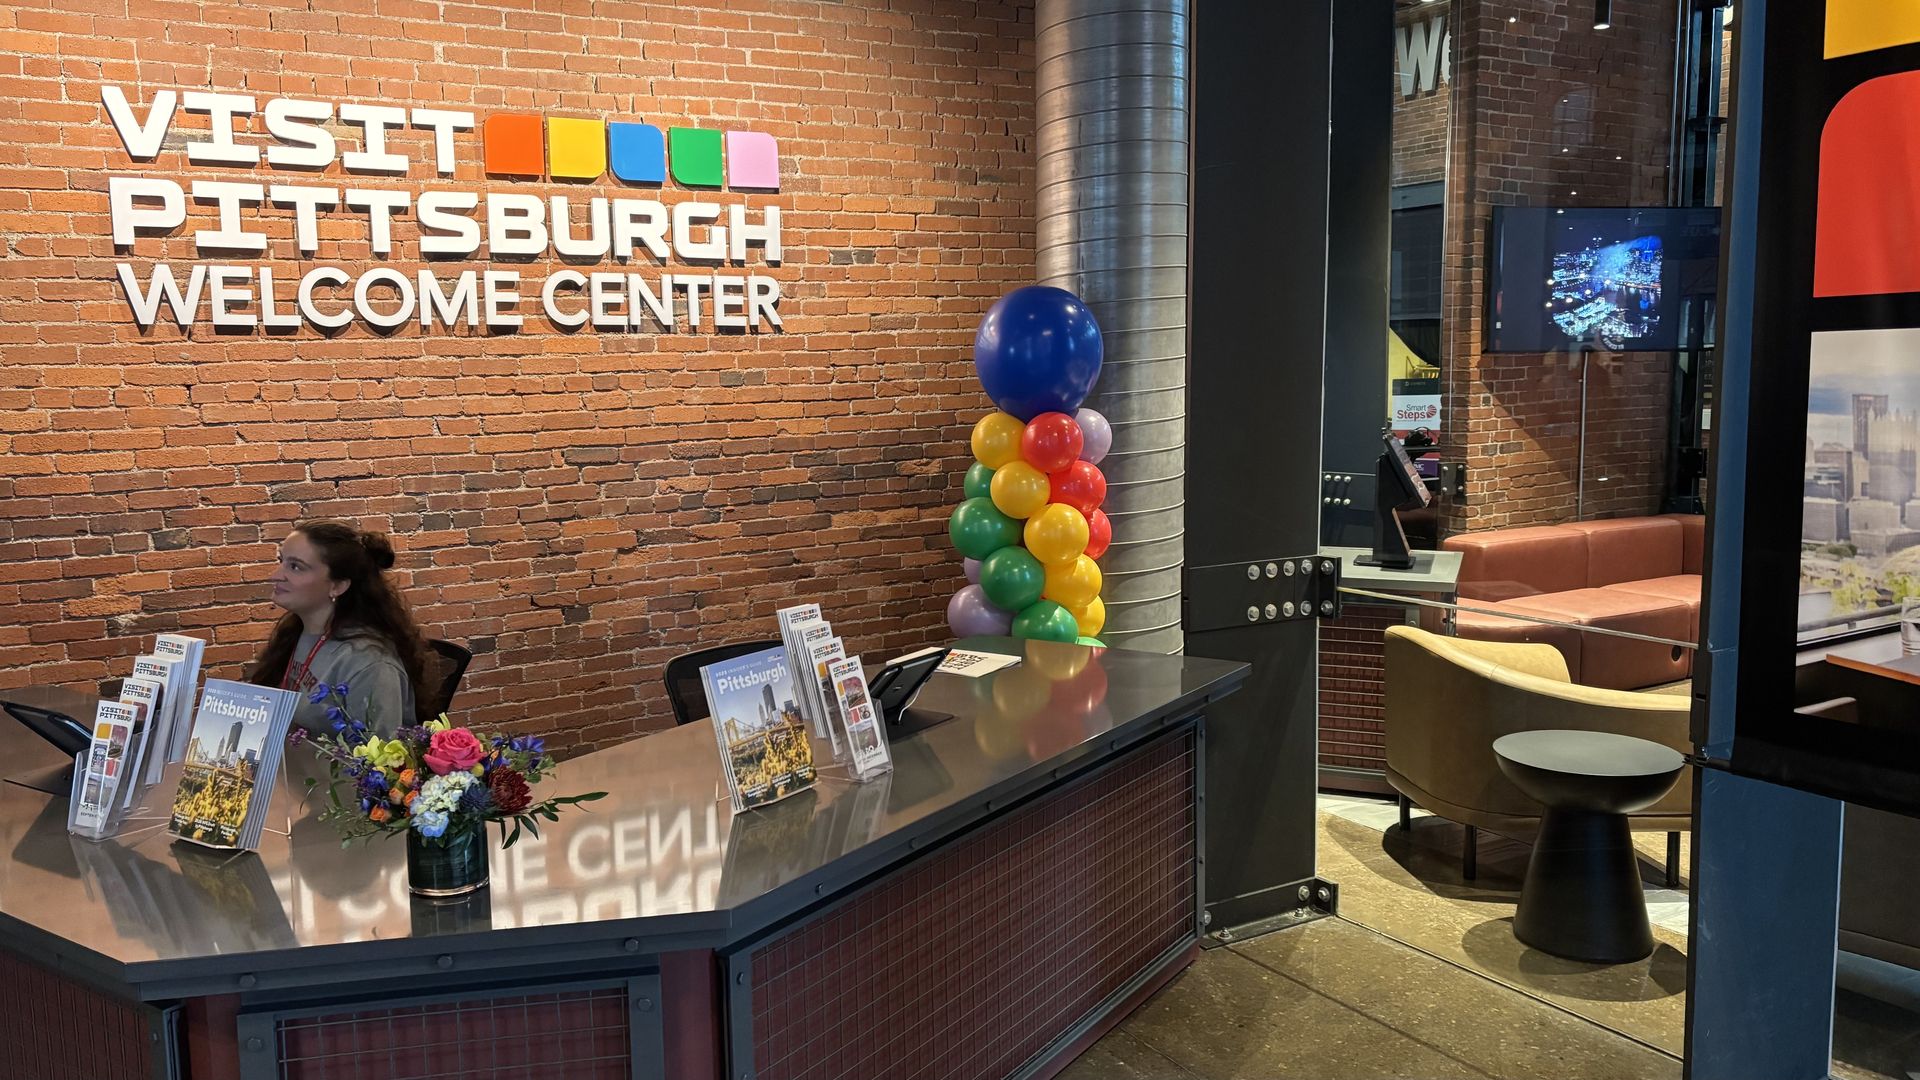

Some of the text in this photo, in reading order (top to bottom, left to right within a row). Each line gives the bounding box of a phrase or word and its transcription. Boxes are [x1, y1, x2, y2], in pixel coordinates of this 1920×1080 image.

[101, 85, 475, 174] VISIT
[108, 176, 782, 263] PITTSBURGH
[116, 262, 783, 333] WELCOME CENTER
[1397, 410, 1426, 421] Steps
[1406, 404, 1427, 412] Smart
[717, 663, 787, 694] Pittsburgh
[101, 706, 122, 714] VISIT
[202, 694, 268, 725] Pittsburgh
